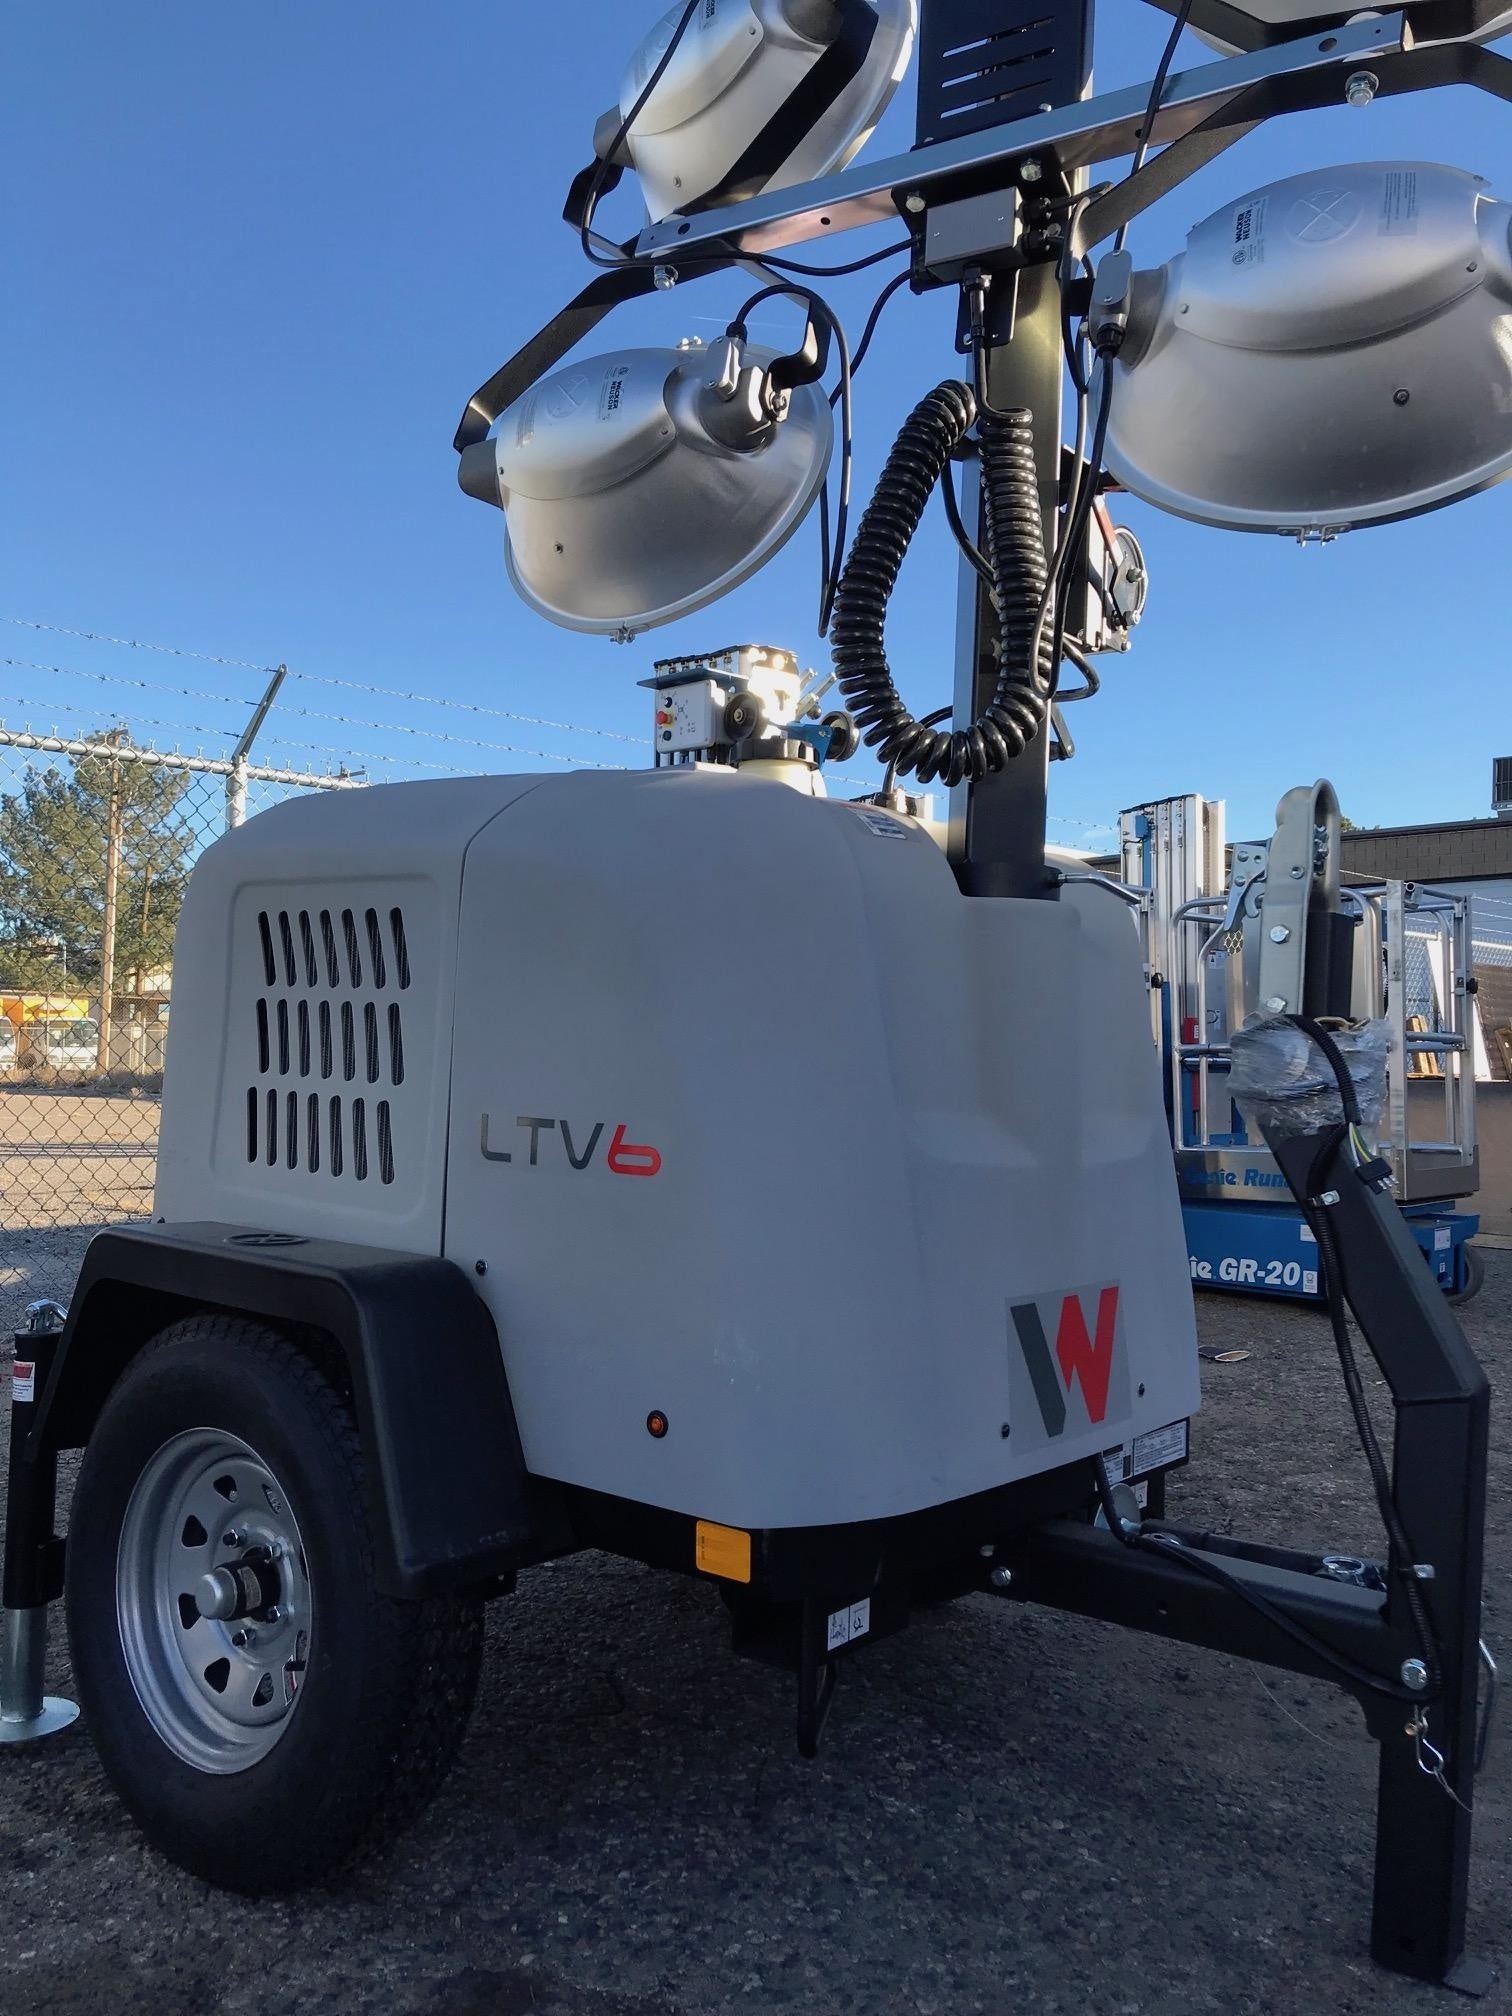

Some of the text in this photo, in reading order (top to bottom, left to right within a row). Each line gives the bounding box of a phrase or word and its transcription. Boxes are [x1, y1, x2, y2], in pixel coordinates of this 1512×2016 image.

[1243, 209, 1253, 240] NEUSON
[607, 381, 618, 410] NEUSON
[481, 1113, 662, 1177] LTV6
[1219, 1257, 1301, 1287] GR-20
